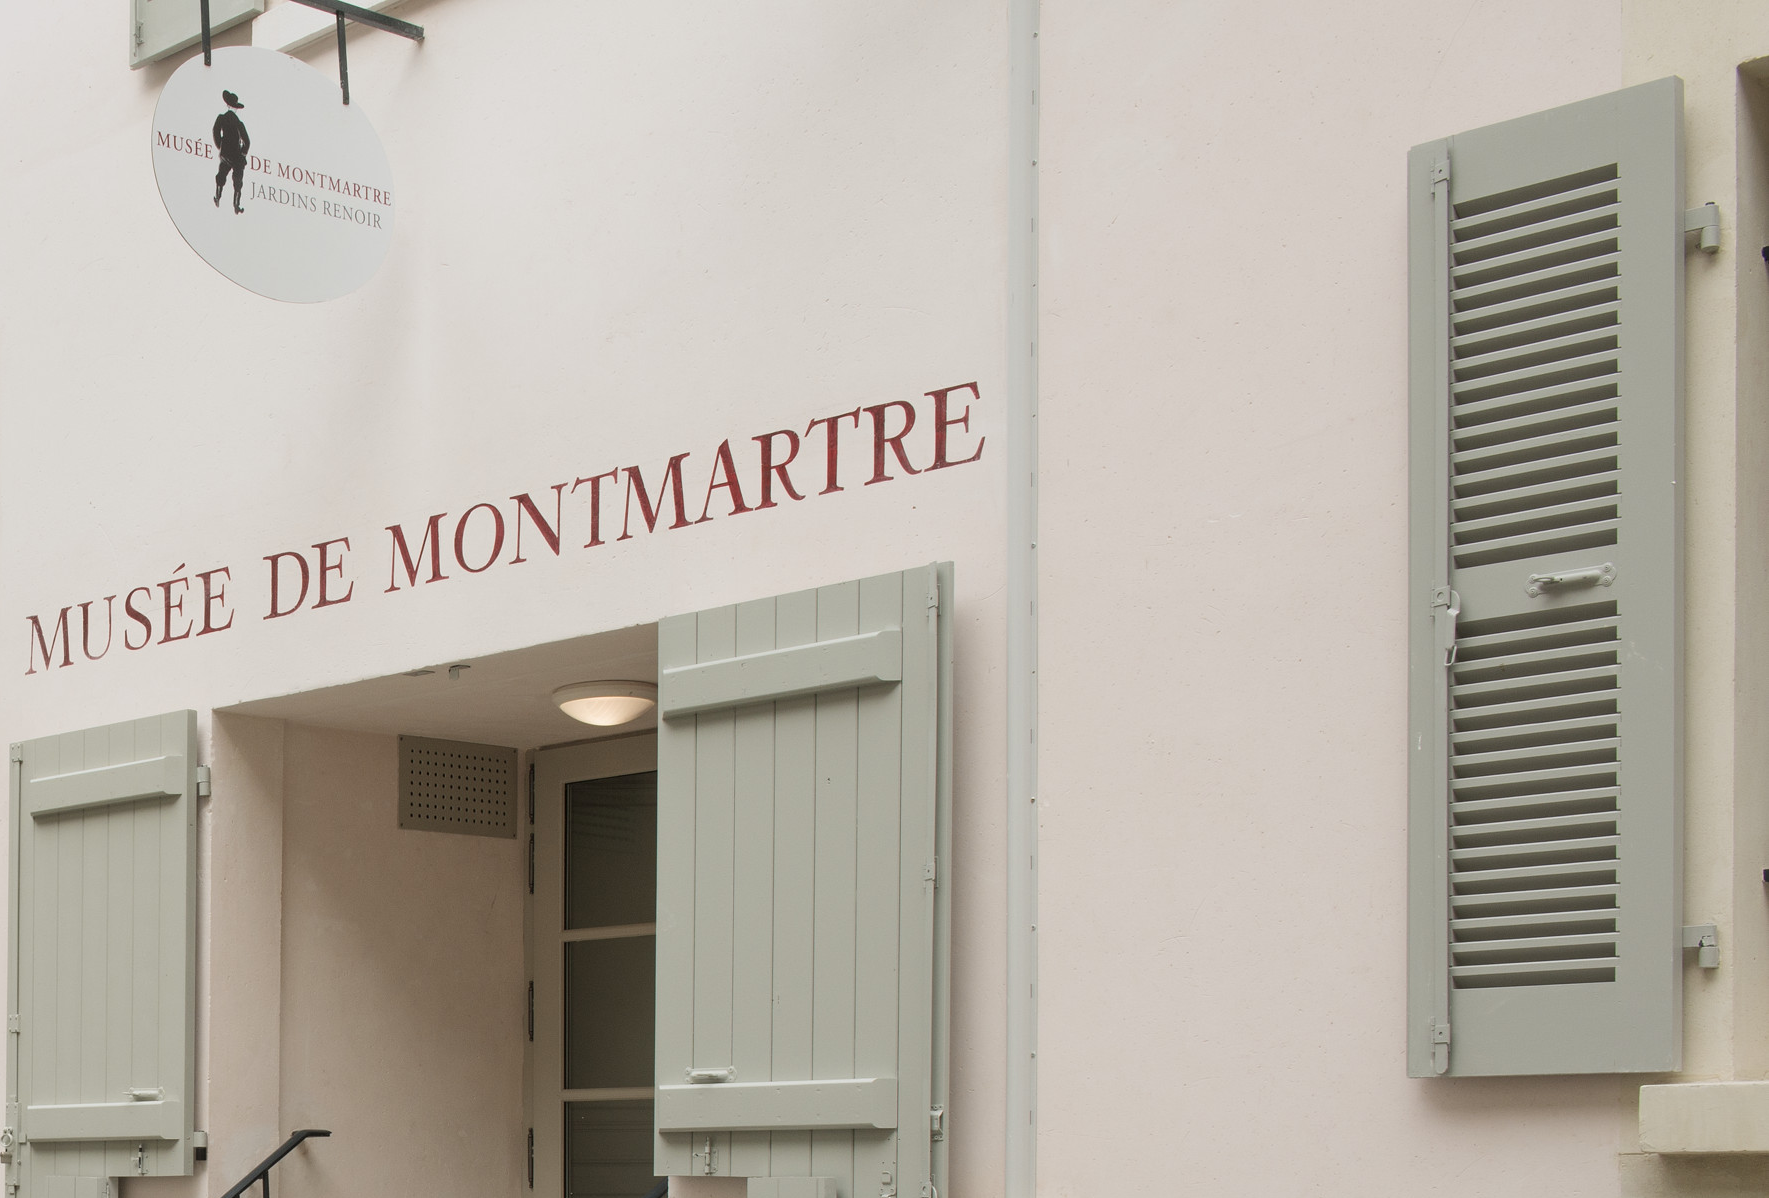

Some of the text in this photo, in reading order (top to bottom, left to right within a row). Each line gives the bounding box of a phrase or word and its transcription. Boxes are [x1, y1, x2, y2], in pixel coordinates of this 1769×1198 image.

[156, 130, 392, 207] MUSÉE DE MONTMARTRE
[249, 181, 383, 230] JARDINS RENOIR
[23, 381, 987, 677] MUSÉE DE MONTMARTRE
